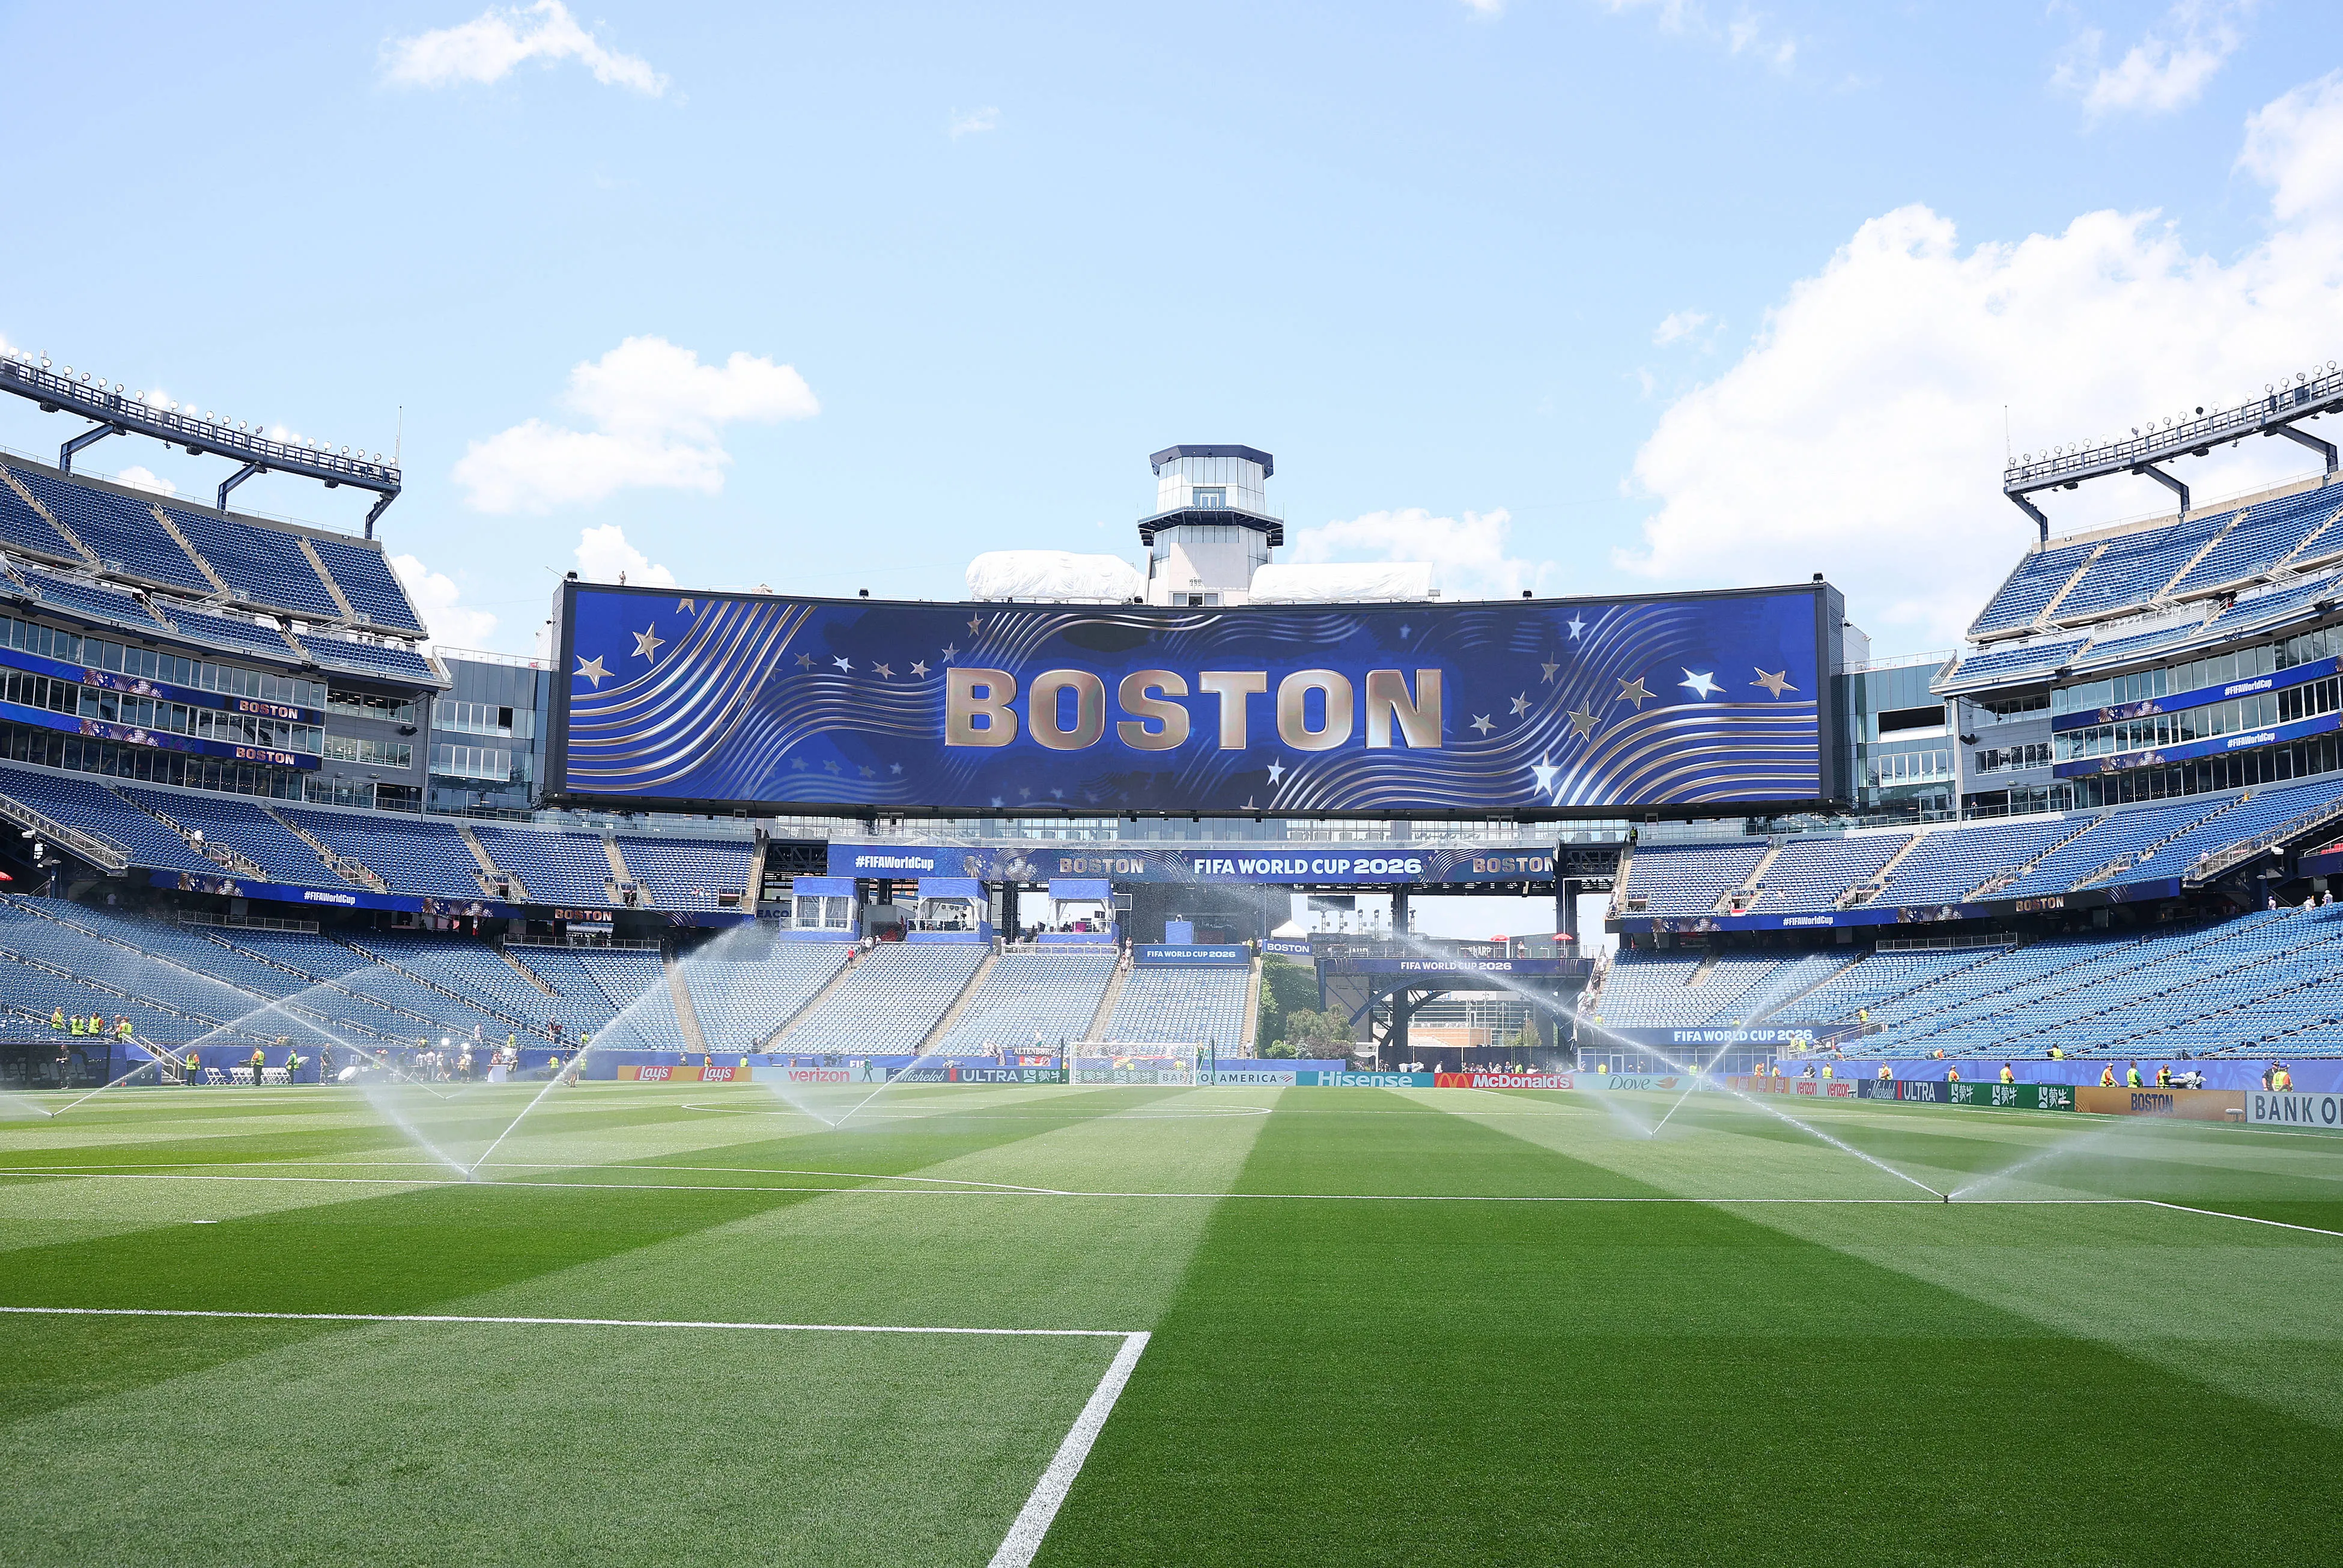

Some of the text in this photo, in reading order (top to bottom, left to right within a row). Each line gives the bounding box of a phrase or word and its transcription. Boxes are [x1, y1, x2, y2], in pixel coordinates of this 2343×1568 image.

[2224, 678, 2273, 696] #FIFAWorldCup
[239, 699, 299, 720] BOSTON
[944, 667, 1443, 751] BOSTON
[2226, 732, 2276, 748] #FIFAWorldCup
[236, 746, 295, 765] BOSTON
[855, 855, 934, 871] #FIFAWorldCup
[1059, 858, 1144, 874] BOSTON
[1194, 858, 1422, 874] FIFA WORLD CUP 2026
[1472, 857, 1554, 874] BOSTON
[303, 890, 356, 905] #FIFAWorldCup
[2016, 896, 2064, 912] BOSTON
[555, 908, 613, 922] BOSTON
[1782, 916, 1834, 926] #FIFAWorldCup
[1266, 943, 1310, 953] BOSTON
[1400, 962, 1512, 970] FIFA WORLD CUP 2026
[1674, 1029, 1813, 1042] FIFA WORLD CUP 2026
[640, 1066, 669, 1081] Lay's
[704, 1066, 732, 1081] Lay's
[788, 1068, 849, 1081] verizon
[887, 1068, 1019, 1082] Michelob ULTRA
[1220, 1074, 1278, 1083] AMERICA
[1317, 1071, 1413, 1087] Hisense
[1472, 1074, 1571, 1088] McDonald's
[1609, 1075, 1650, 1090] Dove
[1796, 1081, 1817, 1096] verizon
[1826, 1083, 1850, 1097] verizon
[1866, 1080, 1936, 1101] Michelob ULTRA
[1959, 1085, 1974, 1103] 蒙牛
[2000, 1087, 2017, 1106] 蒙牛
[2131, 1093, 2174, 1112] BOSTON
[2255, 1095, 2314, 1122] BANK
